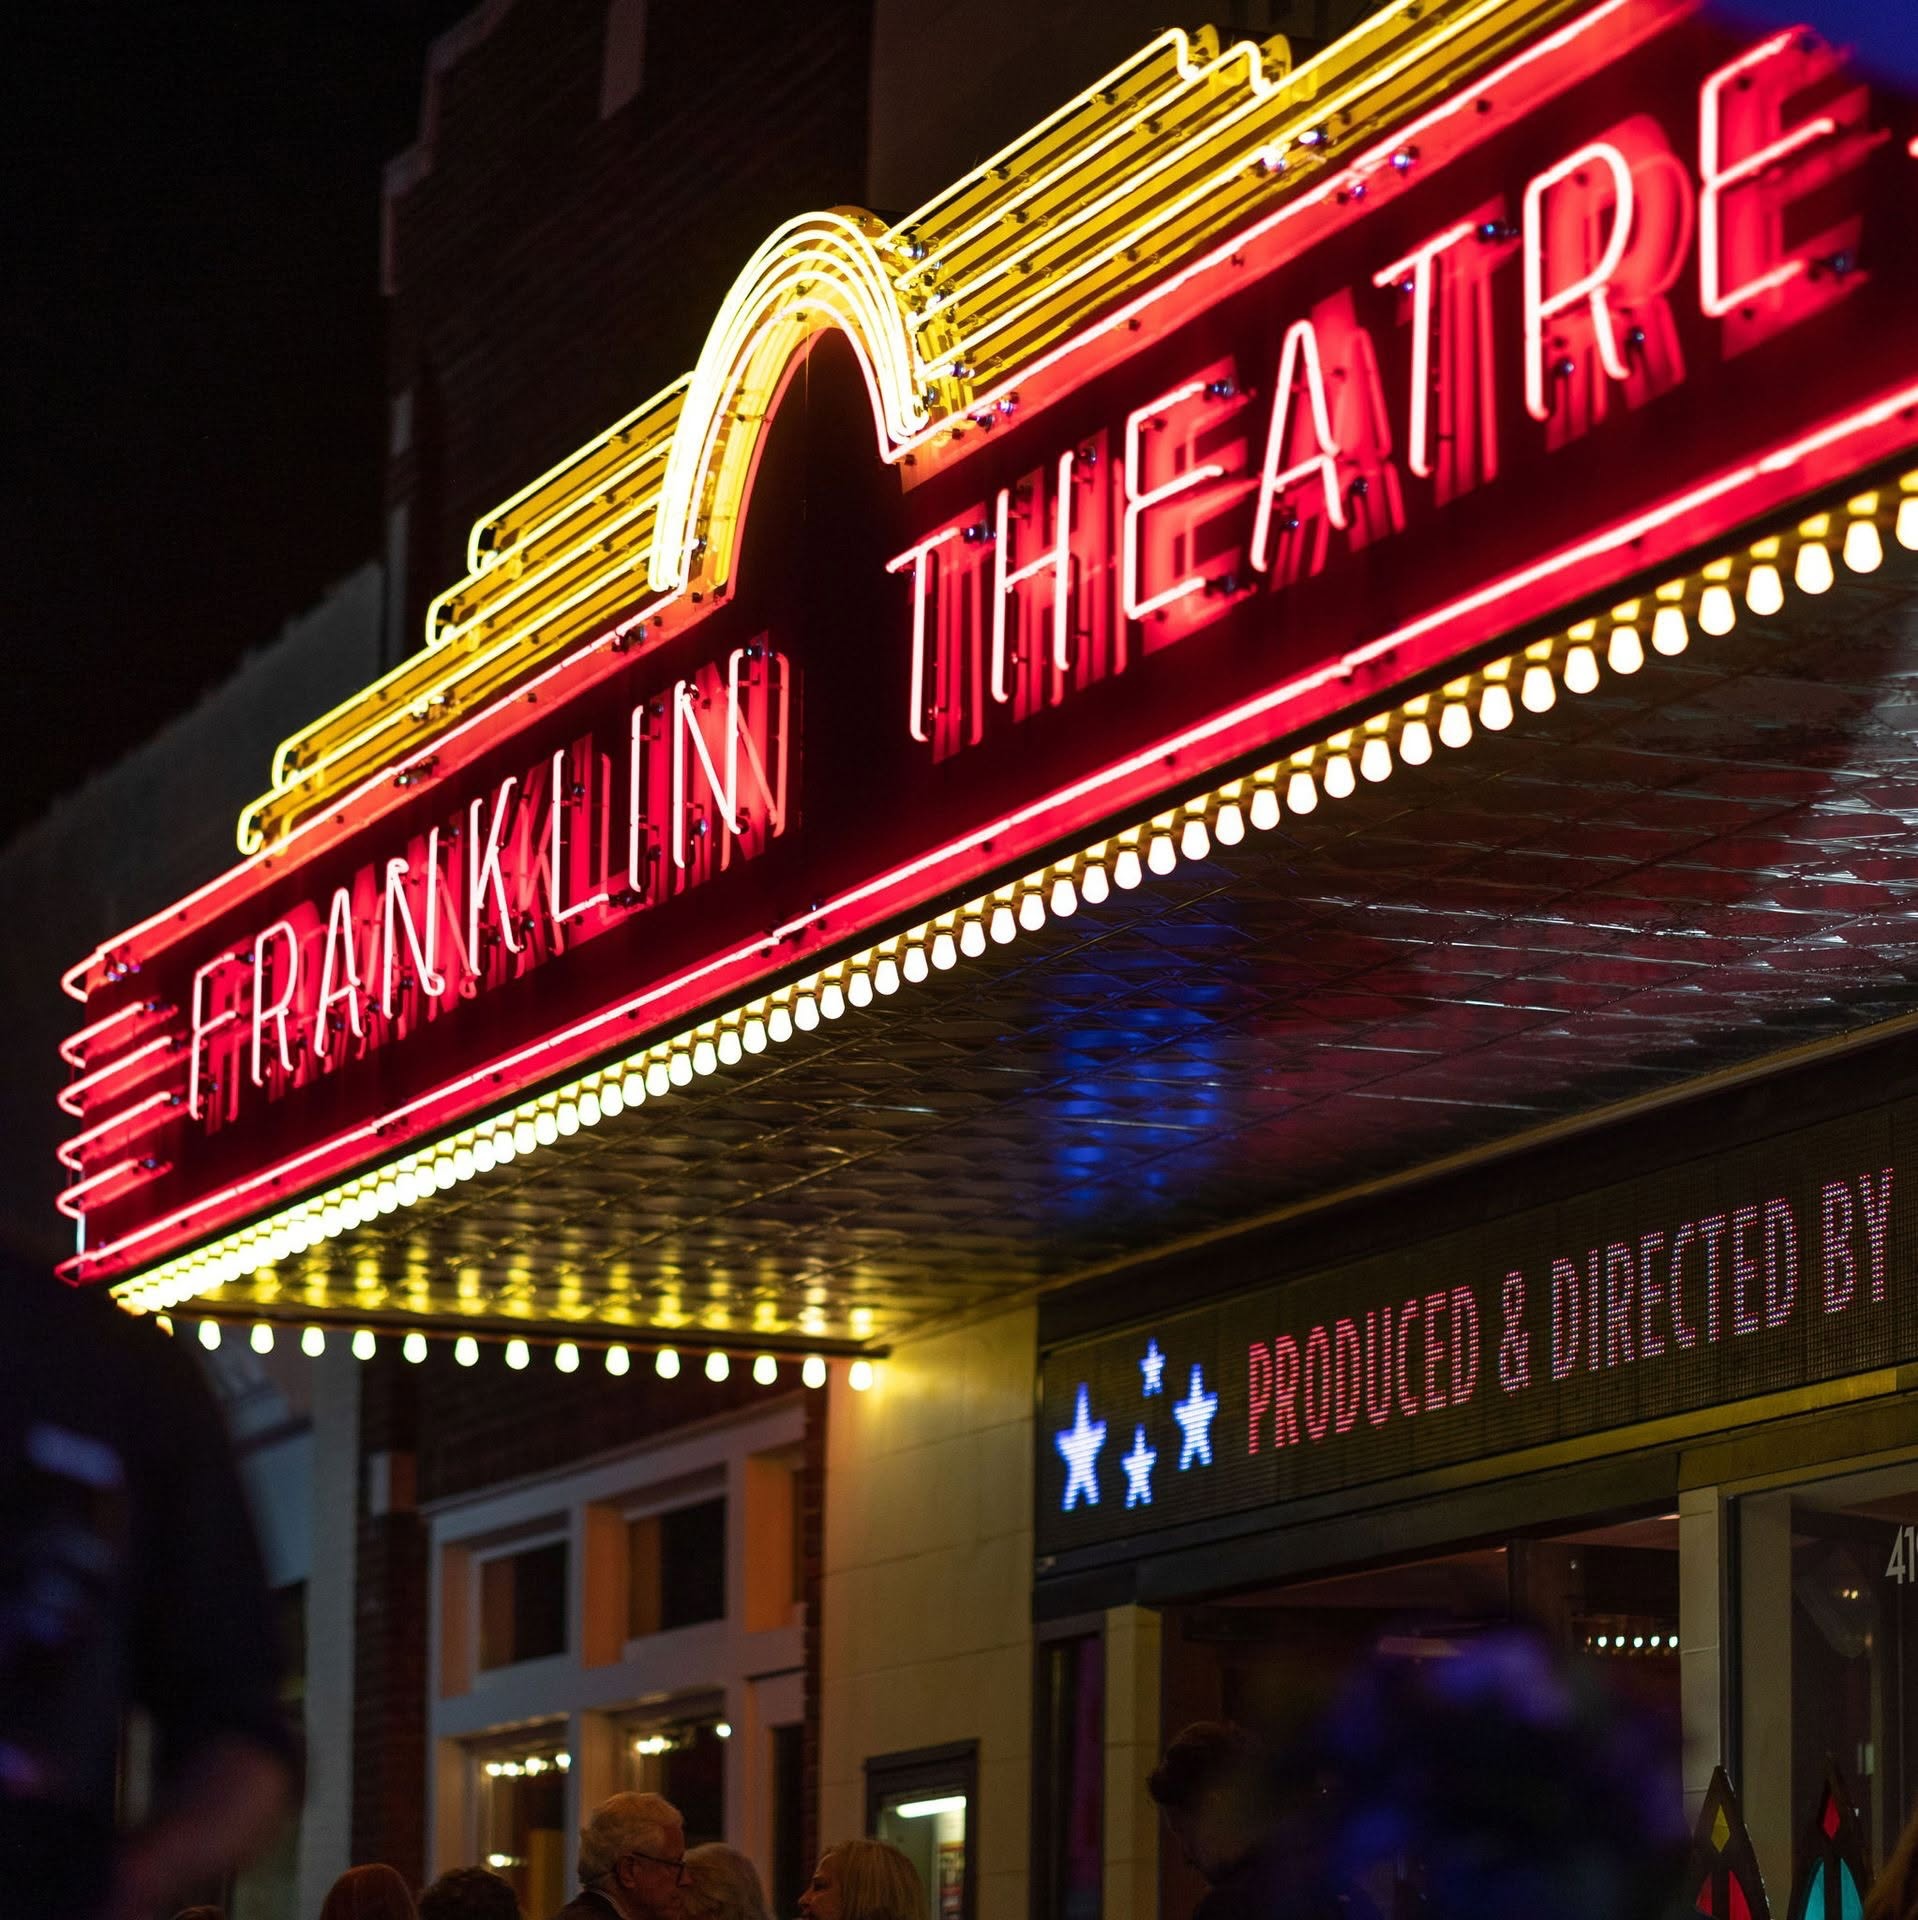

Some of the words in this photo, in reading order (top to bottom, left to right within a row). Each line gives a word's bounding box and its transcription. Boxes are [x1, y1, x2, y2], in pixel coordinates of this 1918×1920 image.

[189, 648, 746, 1121] FRANKLIN
[885, 25, 1836, 746] THEATRE
[1248, 1284, 1481, 1455] PRODUCED
[1499, 1270, 1532, 1398] &
[1551, 1197, 1798, 1382] DIRECTED
[1821, 1167, 1894, 1314] BY
[1884, 1524, 1918, 1584] 41
